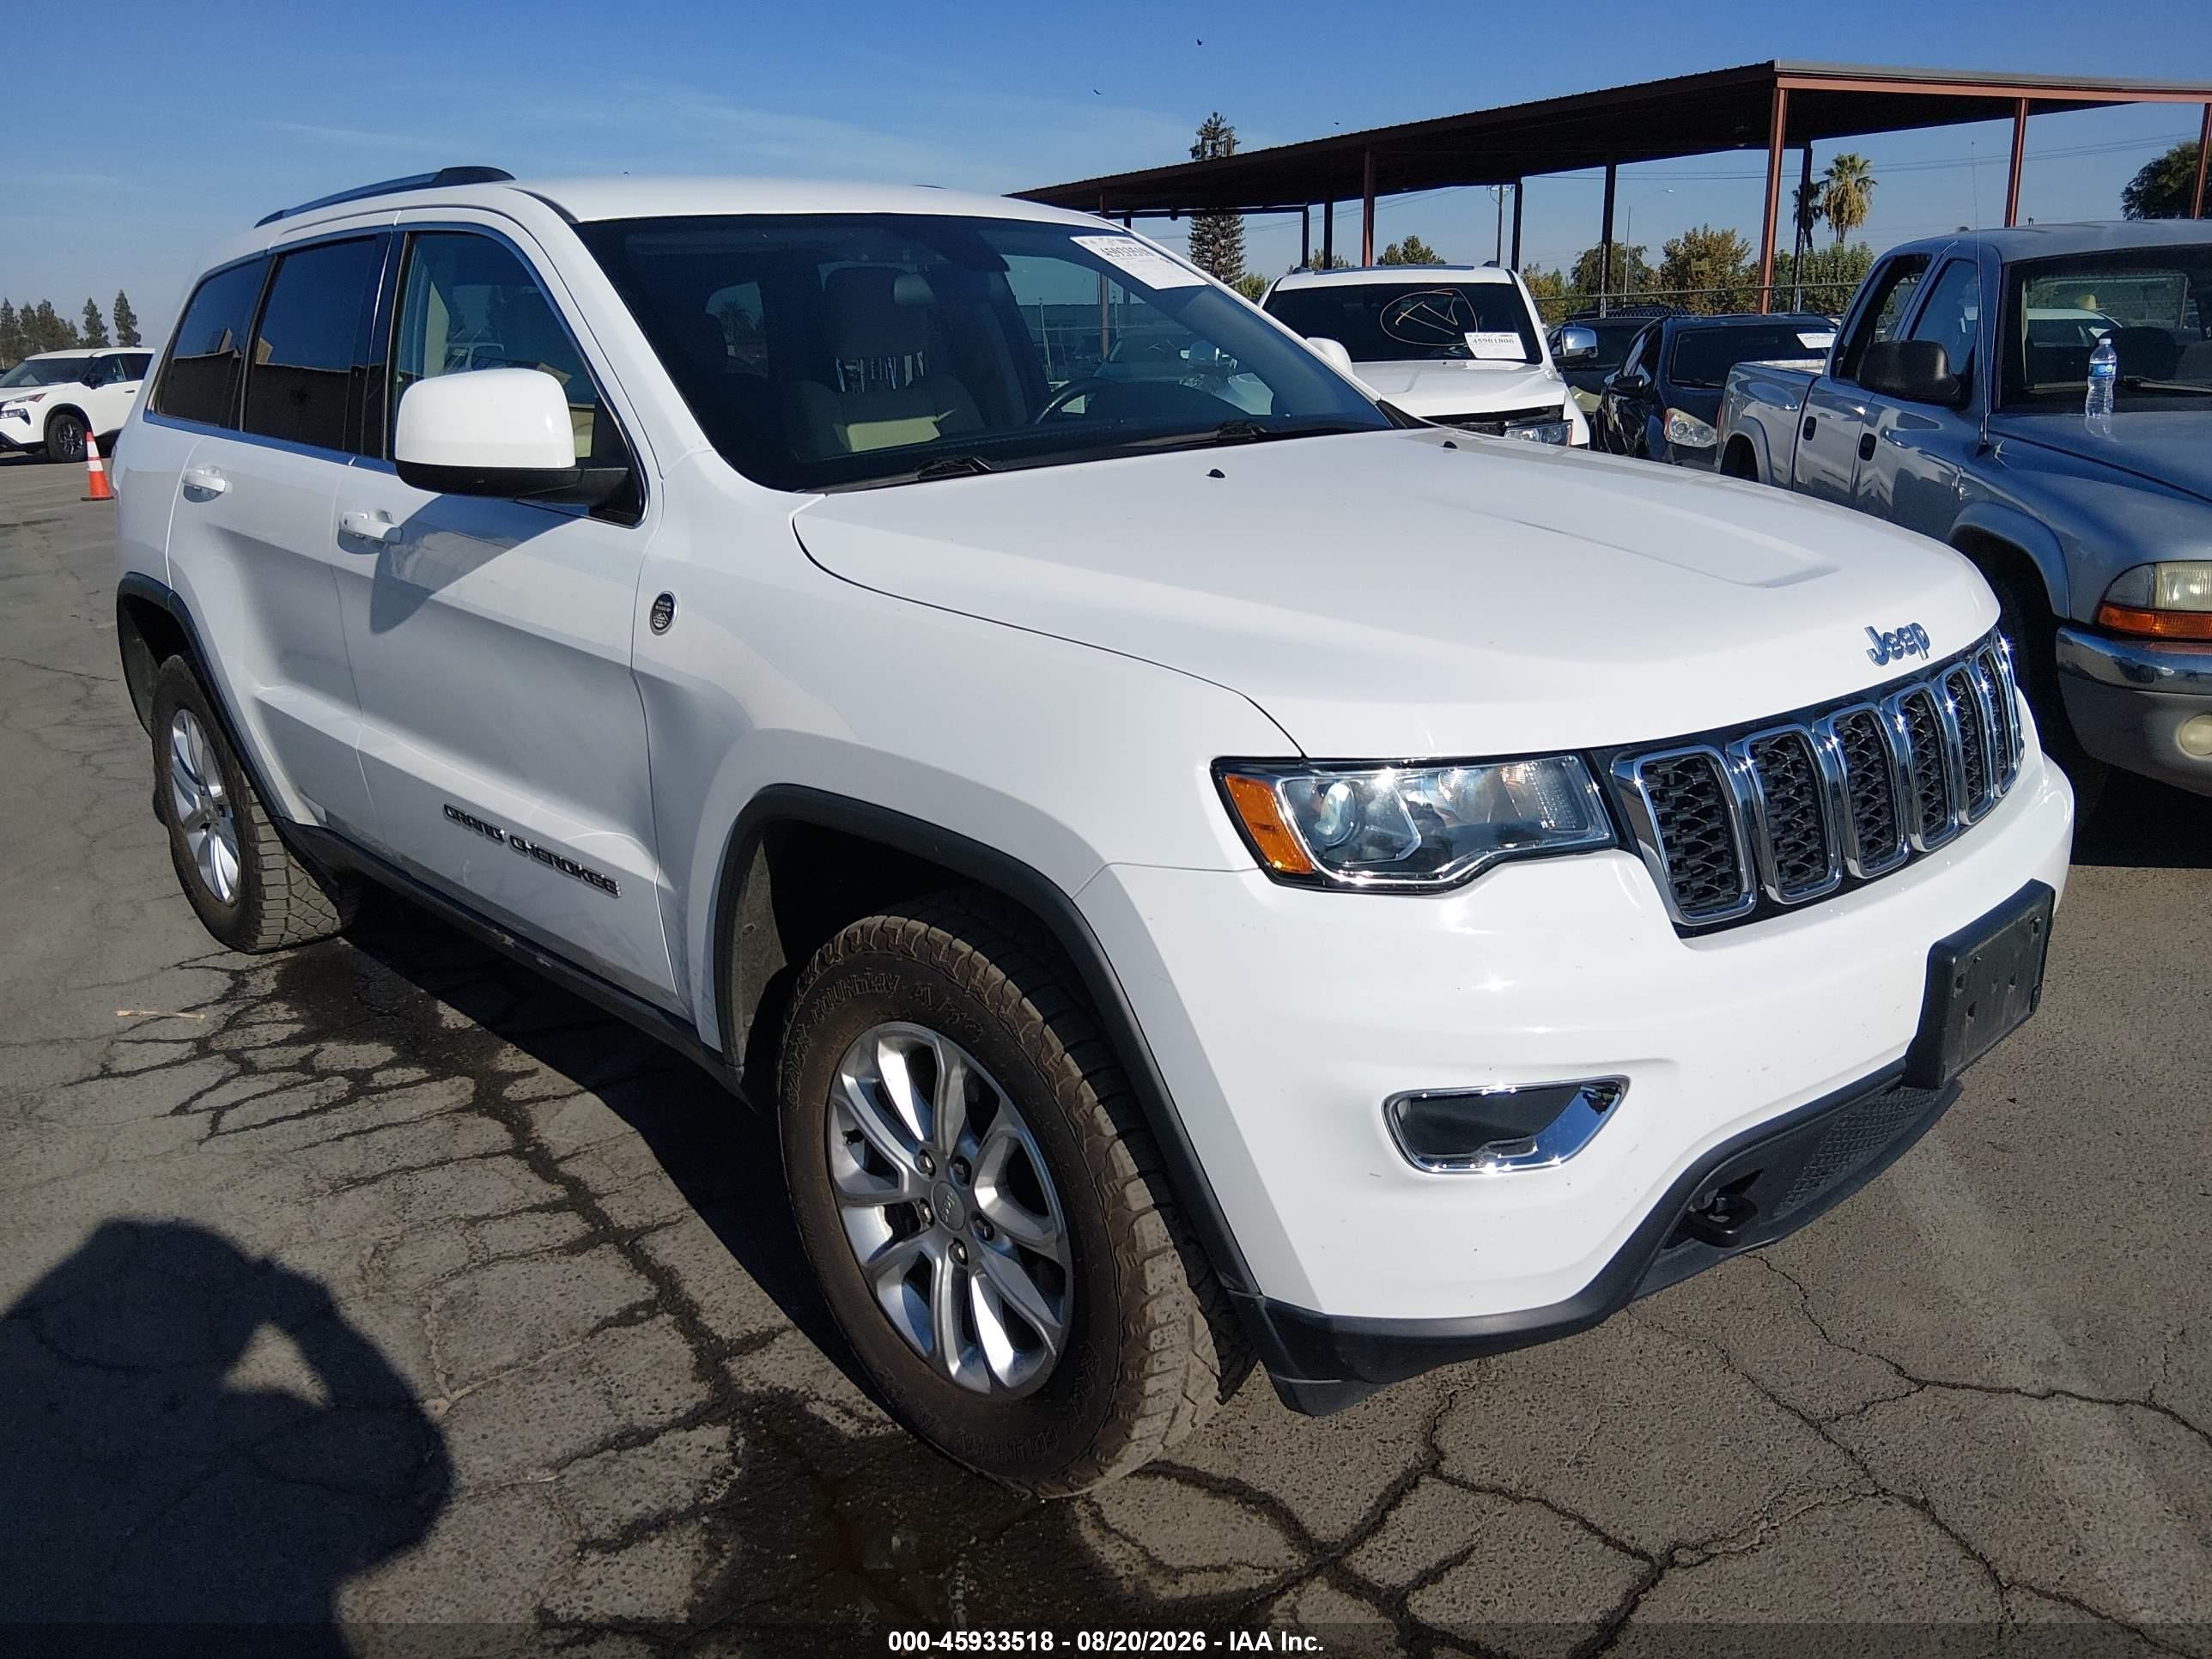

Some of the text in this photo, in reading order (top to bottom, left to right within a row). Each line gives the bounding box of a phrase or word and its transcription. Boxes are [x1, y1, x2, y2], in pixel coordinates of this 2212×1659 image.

[1864, 622, 1930, 667] Jeep
[443, 803, 622, 898] GRAND CHEROKEE
[811, 969, 900, 1025] COUNTRY
